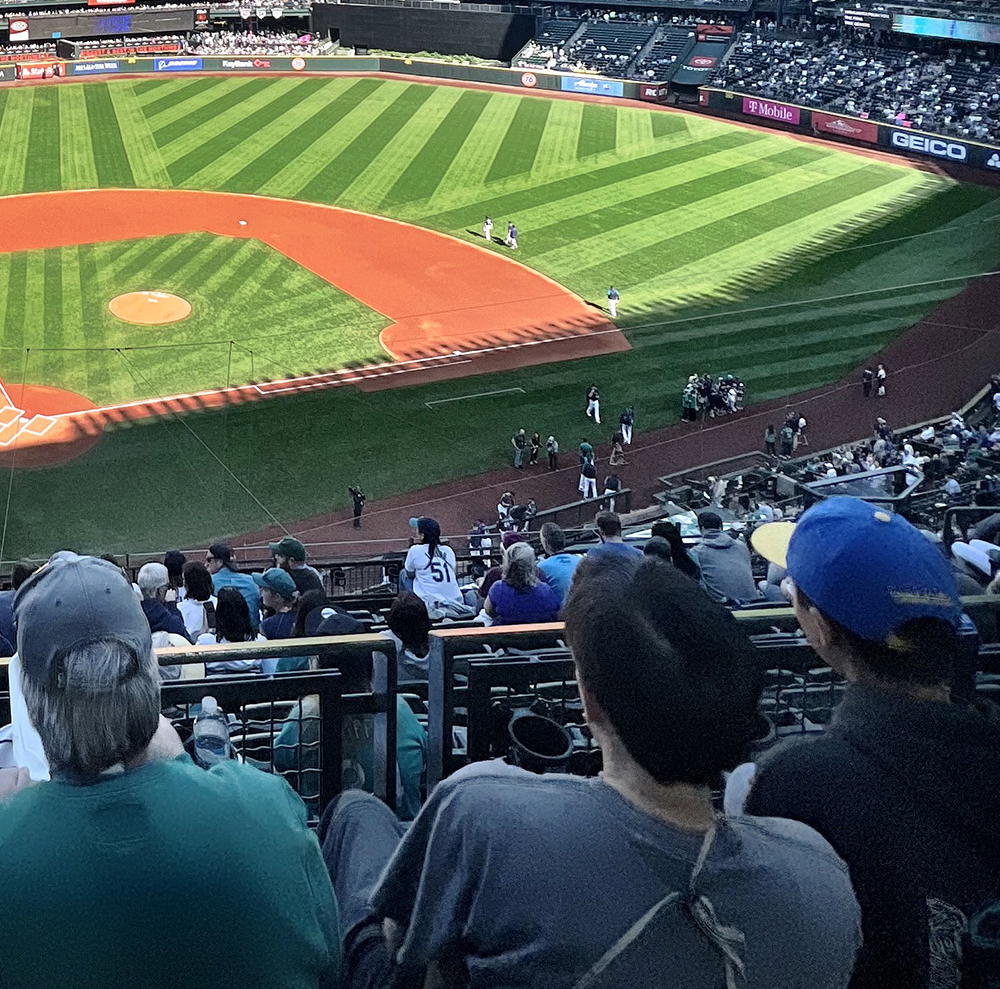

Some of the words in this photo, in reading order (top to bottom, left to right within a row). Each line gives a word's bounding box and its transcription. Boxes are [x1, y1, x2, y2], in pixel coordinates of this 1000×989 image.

[525, 76, 534, 84] 76
[759, 102, 792, 121] Mobile
[892, 132, 967, 159] GEICO
[431, 562, 450, 582] 51
